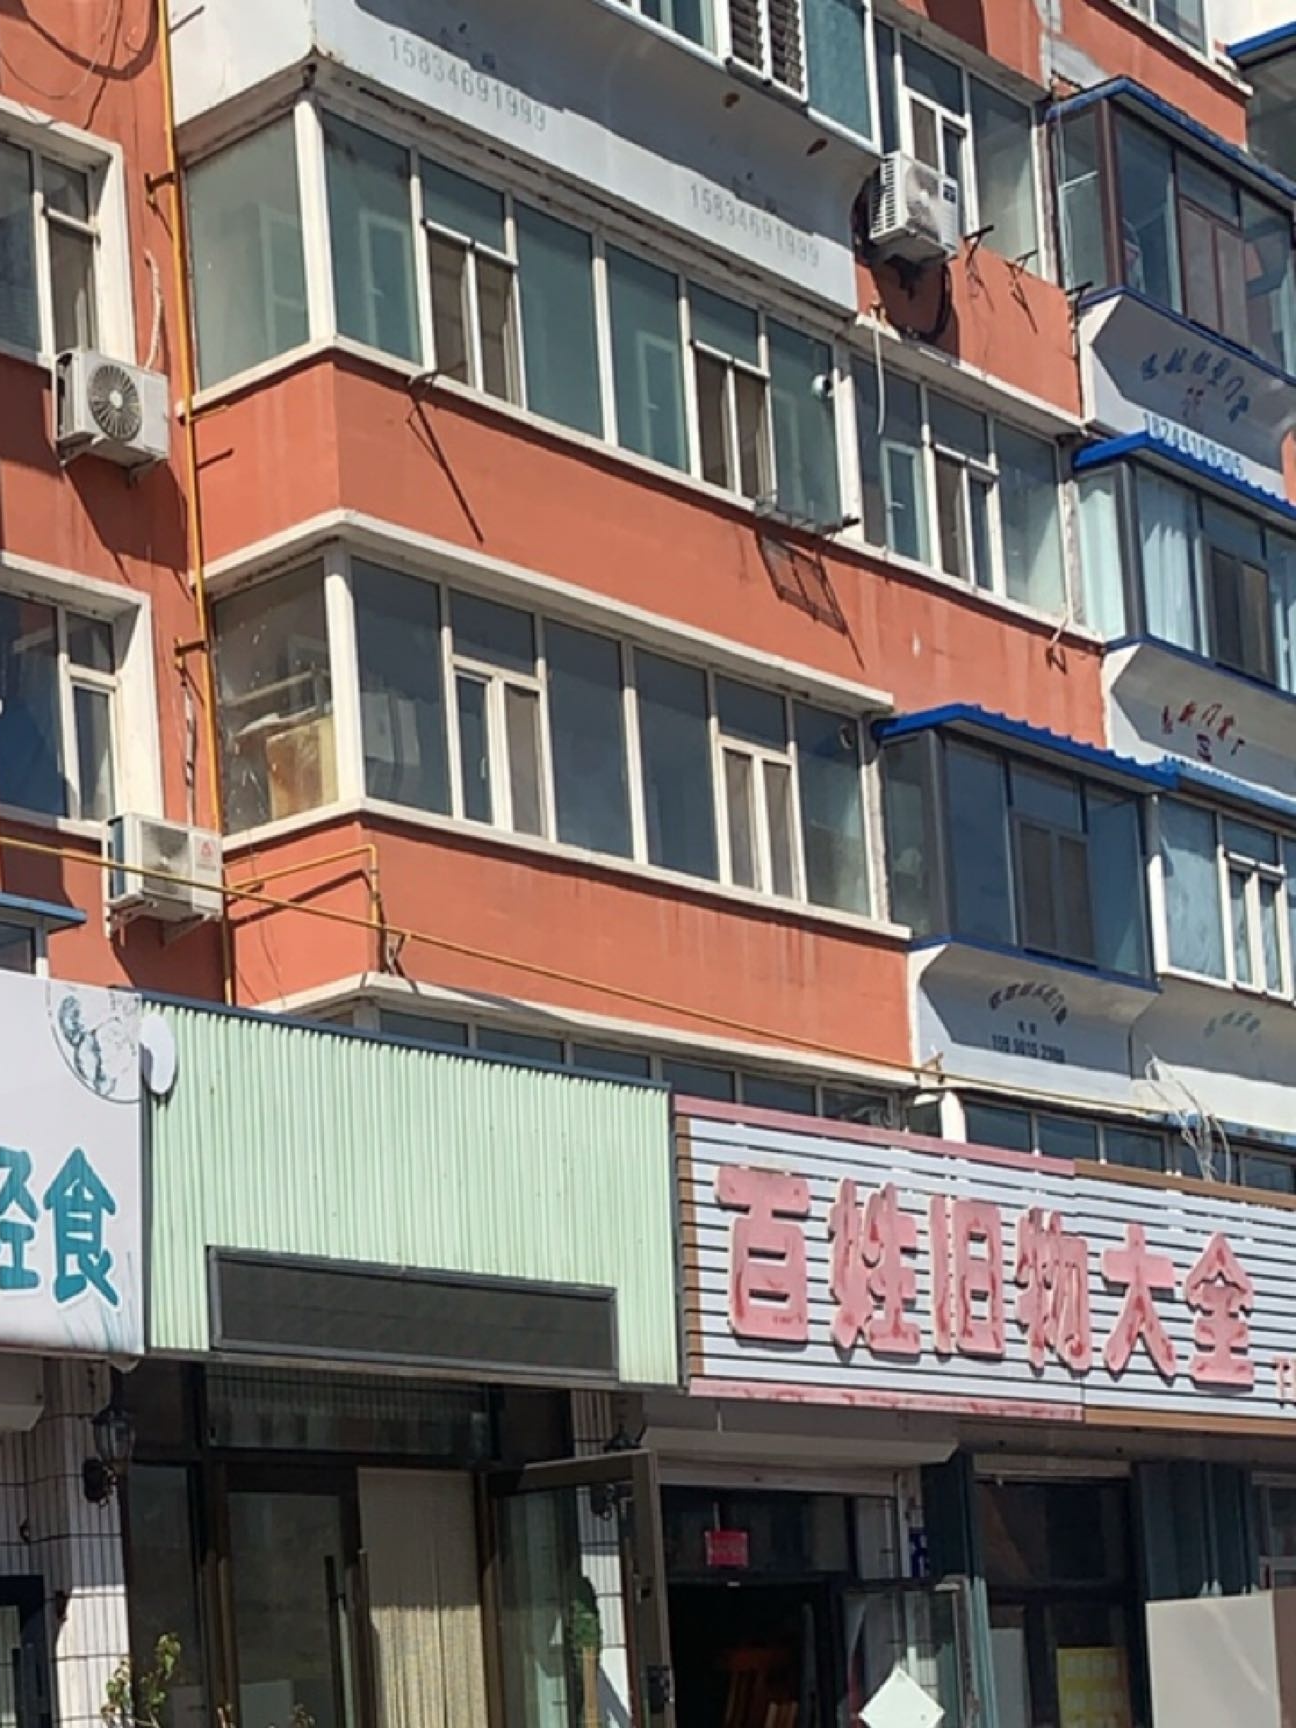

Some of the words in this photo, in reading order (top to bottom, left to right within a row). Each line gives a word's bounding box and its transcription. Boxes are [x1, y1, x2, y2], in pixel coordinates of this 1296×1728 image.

[389, 34, 546, 131] 15834691999
[714, 1164, 1256, 1385] 百姓旧物大全
